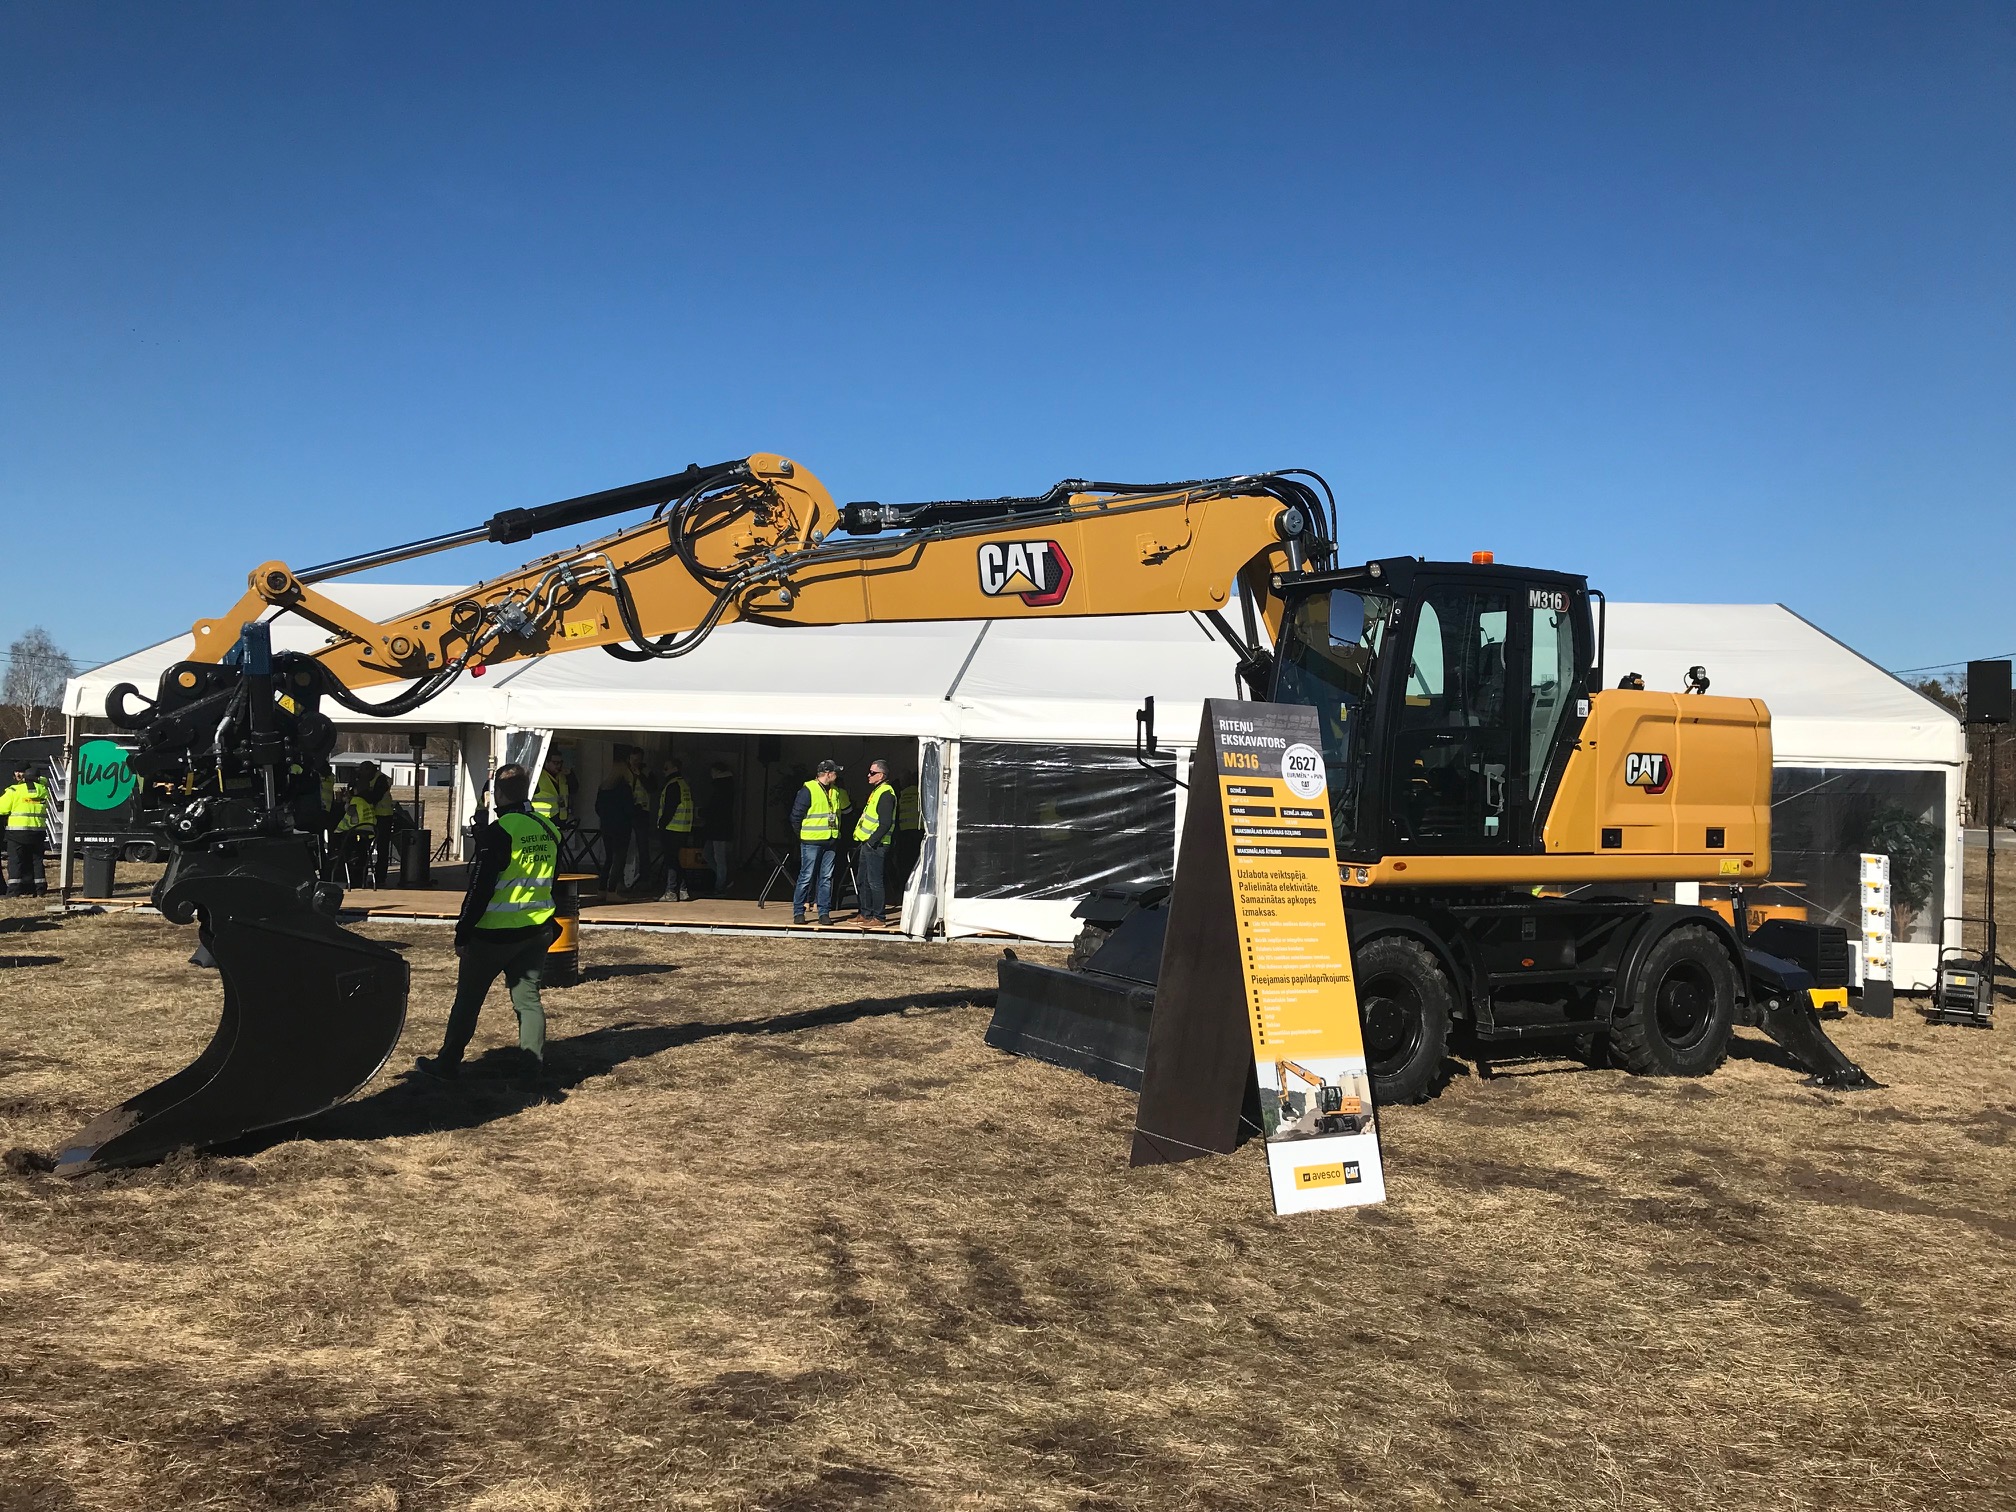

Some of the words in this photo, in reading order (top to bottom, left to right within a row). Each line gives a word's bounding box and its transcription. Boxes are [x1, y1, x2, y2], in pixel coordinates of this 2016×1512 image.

[979, 542, 1048, 594] CAT
[1529, 590, 1562, 610] M316
[1219, 720, 1254, 734] RITEŅU
[1220, 734, 1286, 749] EKSKAVATORS
[1223, 752, 1259, 769] M316
[1289, 756, 1316, 771] 2627
[1626, 753, 1662, 784] CAT
[1237, 869, 1268, 879] Uzlabota
[1238, 881, 1278, 891] Palielināta
[1240, 894, 1286, 904] Samazinātas
[1287, 895, 1317, 906] apkopes
[1242, 907, 1277, 917] izmaksas.
[1251, 974, 1290, 986] Pieejamais
[1312, 1169, 1341, 1181] avesco
[1345, 1166, 1359, 1179] CAT
